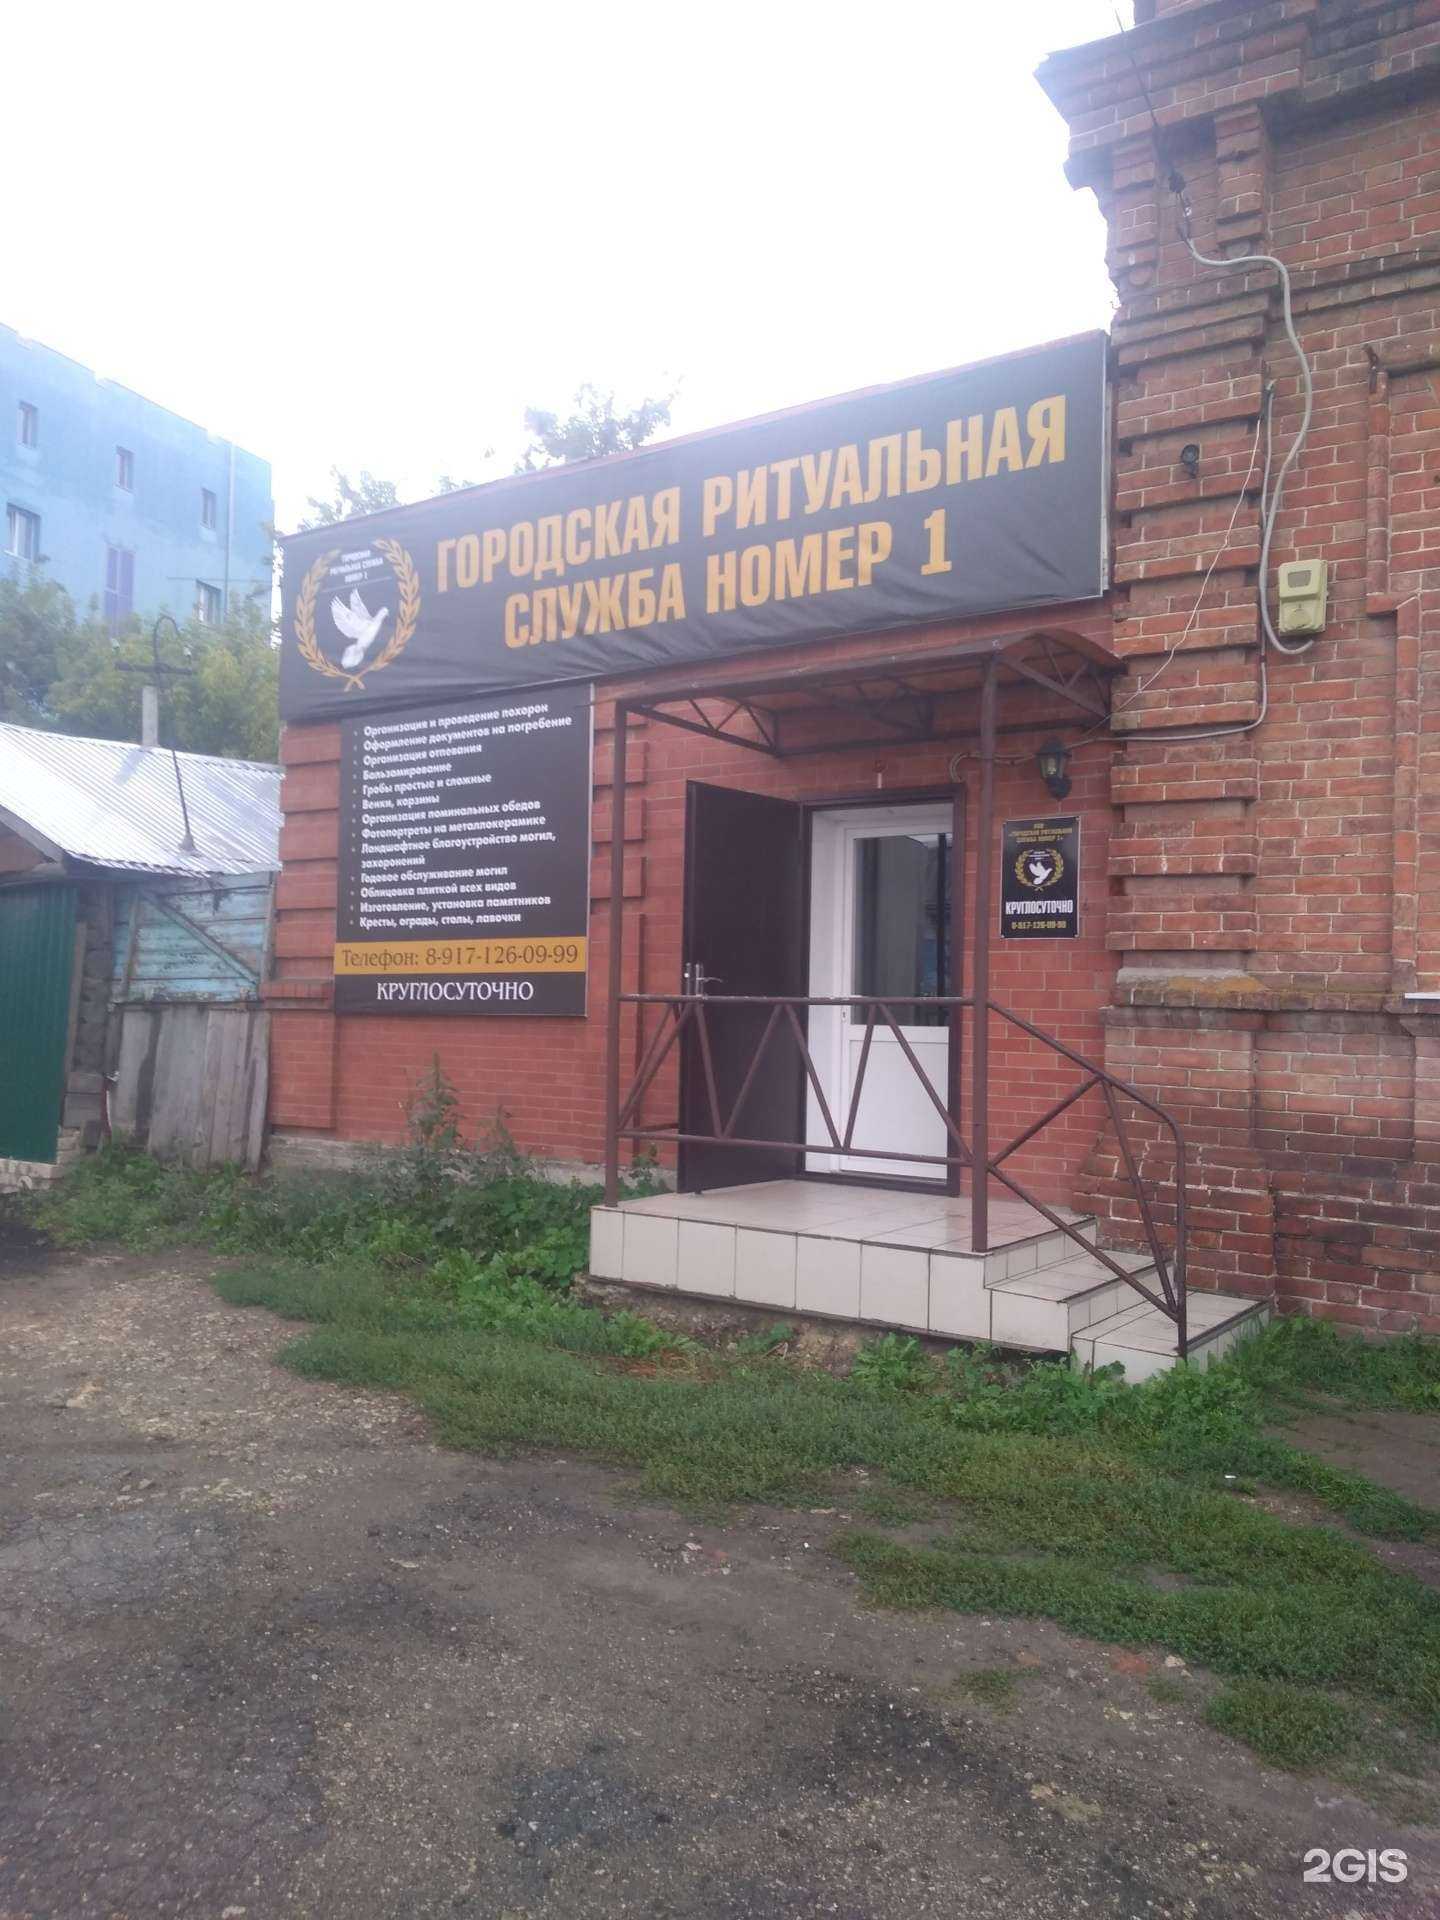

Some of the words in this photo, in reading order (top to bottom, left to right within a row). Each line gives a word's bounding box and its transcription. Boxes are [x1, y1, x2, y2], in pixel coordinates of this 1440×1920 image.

[437, 486, 681, 593] ГОРОДСКАЯ
[703, 394, 1067, 538] РИТУАЛЬНАЯ
[505, 562, 686, 649] СЛУЖБА
[706, 521, 892, 615] НОМЕР
[921, 508, 953, 576] 1
[363, 720, 428, 738] Организация
[429, 719, 437, 729] и
[438, 711, 500, 729] проведение
[502, 703, 549, 720] похорон
[363, 735, 428, 753] Оформление
[429, 728, 490, 746] документов
[492, 725, 505, 735] на
[507, 716, 573, 734] погребение
[363, 750, 428, 768] Организация
[429, 743, 482, 758] отпевания
[362, 762, 452, 781] Бальзамирование
[362, 782, 393, 798] Гробы
[394, 780, 435, 795] простые
[437, 779, 444, 788] и
[445, 773, 492, 788] сложные
[361, 797, 394, 811] Венки,
[396, 795, 440, 809] корзины
[361, 810, 426, 827] Организация
[428, 804, 500, 819] поминальных
[501, 799, 541, 814] обедов
[361, 825, 432, 842] Фотопортреты
[434, 824, 447, 834] на
[449, 815, 546, 832] металлокерамике
[361, 839, 431, 855] Ландшафтное
[432, 834, 517, 850] благоустройство
[519, 831, 556, 843] могил,
[361, 855, 425, 870] захоронений
[361, 873, 399, 884] Годовое
[400, 868, 474, 883] обслуживание
[475, 866, 508, 877] могил
[360, 886, 415, 898] Облицовка
[416, 883, 458, 896] плиткой
[459, 884, 482, 894] всех
[485, 881, 517, 892] видов
[360, 901, 429, 914] Изготовление,
[432, 899, 484, 912] установка
[486, 896, 551, 908] памятников
[1005, 900, 1073, 915] КРУГЛОСУТОЧНО
[359, 917, 397, 931] Кресты,
[399, 915, 439, 928] ограды,
[441, 914, 474, 926] столы,
[476, 912, 521, 924] лавочки
[343, 949, 418, 970] Телефон:
[425, 945, 578, 966] 8-917-126-09-99
[376, 981, 534, 1000] КРУГЛОСУТОЧНО
